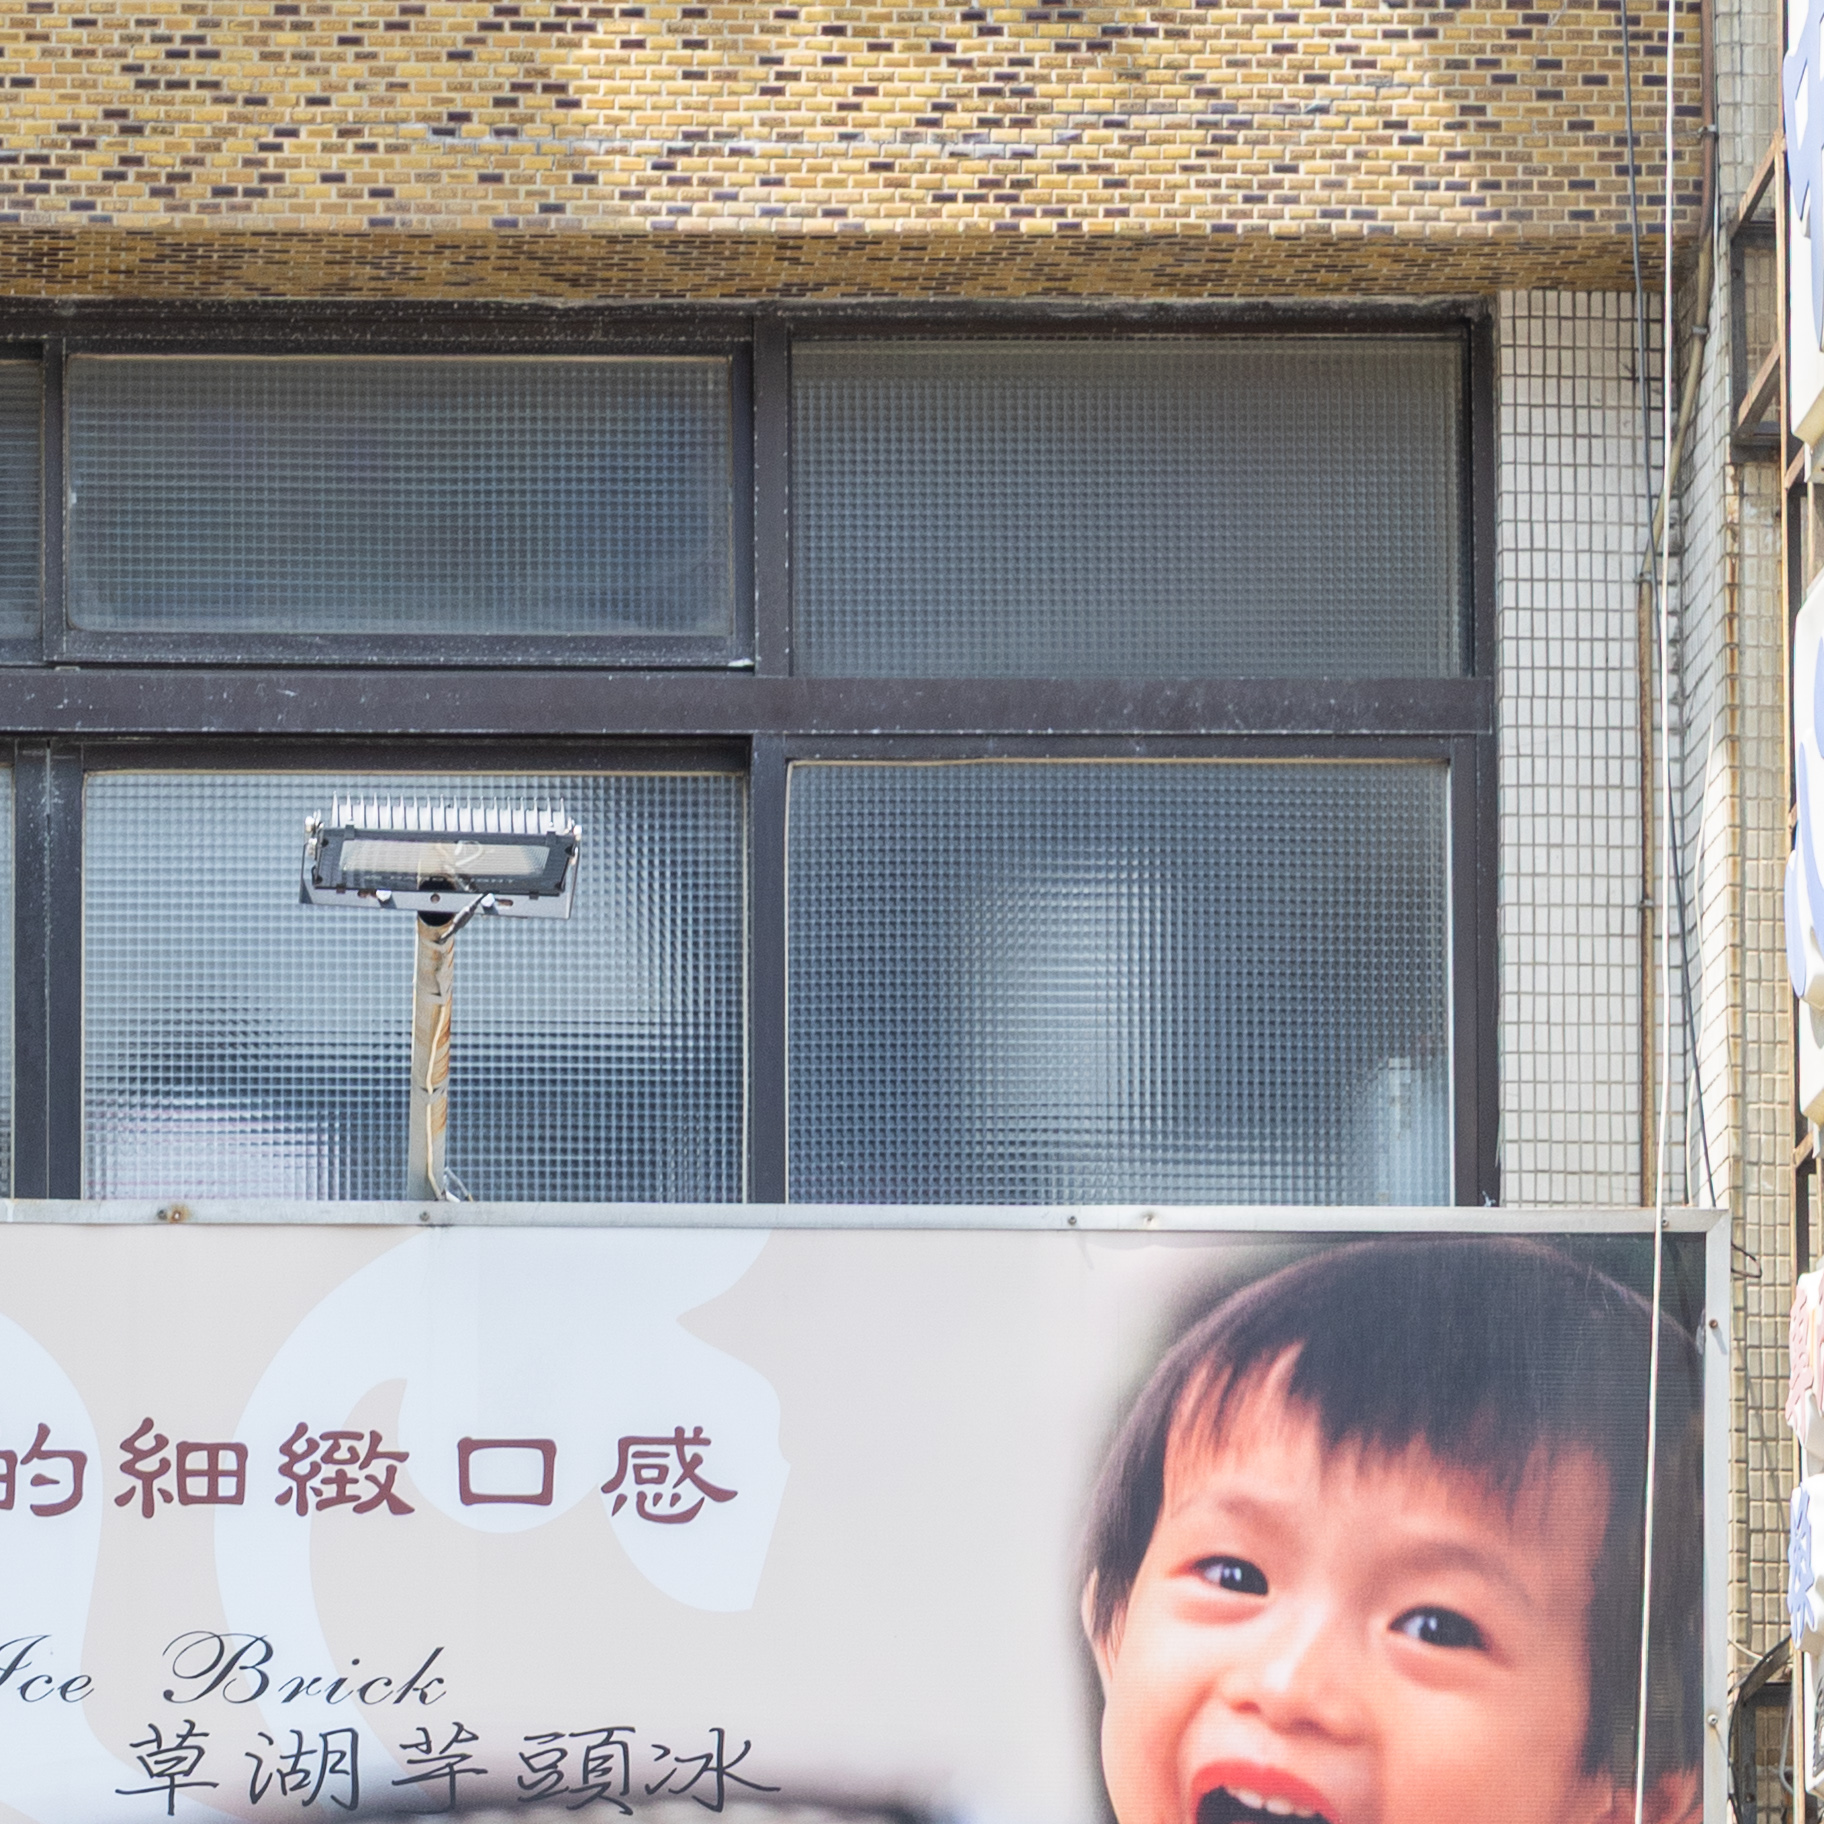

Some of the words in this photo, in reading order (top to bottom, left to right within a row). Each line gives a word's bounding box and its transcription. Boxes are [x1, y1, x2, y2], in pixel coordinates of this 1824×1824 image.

[160, 1630, 447, 1707] Brick
[115, 1720, 781, 1816] 草湖芋頭冰
